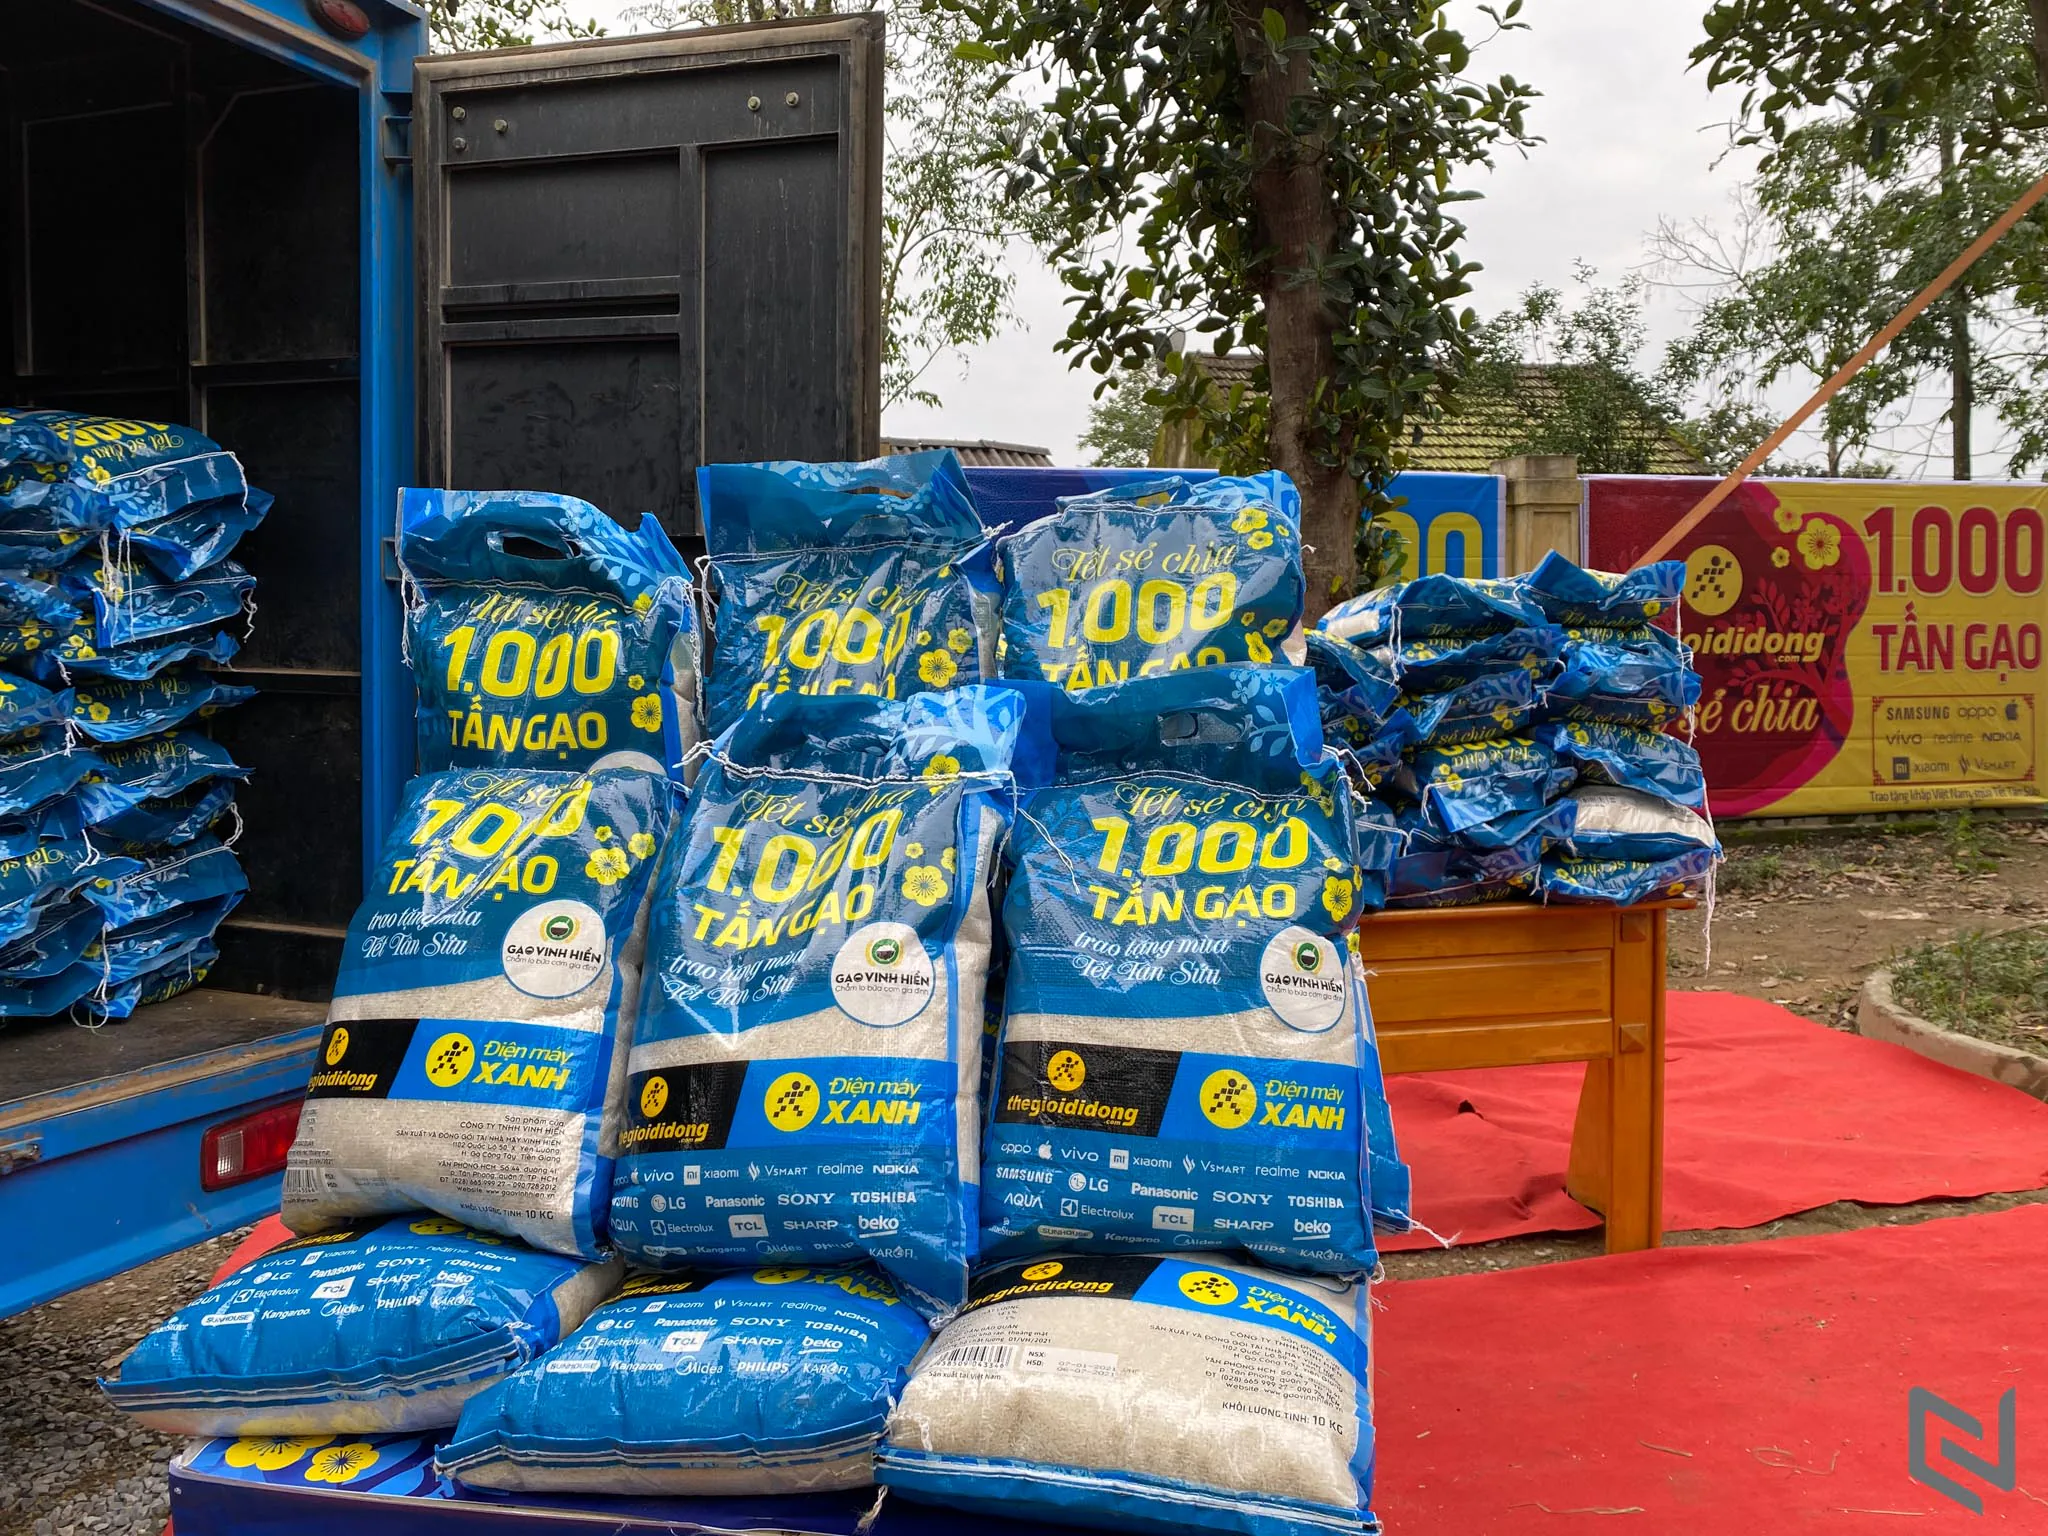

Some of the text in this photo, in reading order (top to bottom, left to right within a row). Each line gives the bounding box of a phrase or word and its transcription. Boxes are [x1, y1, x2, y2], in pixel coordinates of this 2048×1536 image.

[1052, 543, 1110, 583] Tết
[1863, 505, 2044, 596] 1.000
[1036, 571, 1238, 648] 1.000
[1871, 601, 2043, 684] TẤN GẠO
[443, 626, 619, 699] 1.000
[1730, 684, 1820, 734] chia
[1886, 706, 1997, 721] SAMSUNG oppo
[447, 694, 609, 759] TẤN GẠO
[1885, 730, 1923, 745] vivo
[1981, 731, 2022, 742] NOKIA
[742, 790, 807, 827] Tết
[1115, 782, 1180, 819] Tết
[705, 808, 905, 904] 1.000
[1090, 815, 1310, 879] 1.000
[693, 883, 877, 951] TẤN GẠO
[1087, 880, 1297, 928] TẤN GẠO
[361, 935, 388, 959] Tết
[389, 932, 420, 956] Tân
[507, 944, 602, 964] GẠO VINH HIỂN
[1074, 931, 1231, 960] trao tặng mùa
[668, 954, 717, 981] trao
[835, 970, 930, 987] GẠO VINH HIỂN
[1072, 954, 1222, 986] Tết Tân Sửu
[1265, 973, 1291, 986] GẠO
[1292, 976, 1320, 990] VINH
[484, 1039, 574, 1066] Điện máy
[472, 1061, 571, 1091] XANH
[829, 1077, 922, 1097] Điện máy
[1264, 1079, 1344, 1104] Điện máy
[821, 1099, 921, 1125] XANH
[1007, 1095, 1139, 1127] thegioididong
[1103, 1118, 1121, 1126] .com
[1258, 1101, 1345, 1131] XANH
[644, 1169, 674, 1182] vivo
[704, 1168, 740, 1179] xiaomi
[817, 1162, 864, 1176] realme
[872, 1164, 920, 1175] NOKIA
[1001, 1143, 1032, 1155] oppo
[1060, 1146, 1100, 1162] vivo
[1132, 1156, 1172, 1169] xiaomi
[1255, 1165, 1300, 1178] realme
[1307, 1169, 1347, 1181] NOKIA
[668, 1191, 917, 1210] LG Panasonic SONY TOSHIBA
[996, 1166, 1345, 1209] SAMSUNG LG Panasonic SONY TOSHIBA
[524, 1209, 540, 1220] 10
[540, 1210, 555, 1220] KG
[611, 1215, 899, 1233] AQUA Electrolux TCL SHARP beko
[1003, 1192, 1332, 1234] AQUA Electrolux TCL SHARP beko
[262, 1250, 518, 1269] vivo NOKIA
[1299, 1248, 1344, 1261] KAROFI
[270, 1257, 502, 1281] LG Panasonic SONY TOSHIBA
[321, 1285, 347, 1294] TCL
[365, 1273, 421, 1287] SHARP
[435, 1270, 475, 1283] beko
[261, 1307, 312, 1320] Kangaroo
[376, 1295, 424, 1310] PHILIPS
[1248, 1286, 1294, 1307] Điện
[601, 1306, 637, 1315] vivo
[780, 1301, 827, 1313] realme
[834, 1309, 880, 1329] NOKIA
[1239, 1296, 1337, 1344] XANH
[614, 1317, 868, 1343] LG Panasonic SONY TOSHIBA
[672, 1335, 844, 1349] TCL SHARP beko
[610, 1360, 664, 1373] Kangaroo
[686, 1361, 723, 1374] Midea
[737, 1361, 790, 1375] PHILIPS
[1312, 1415, 1344, 1436] 10 KG
